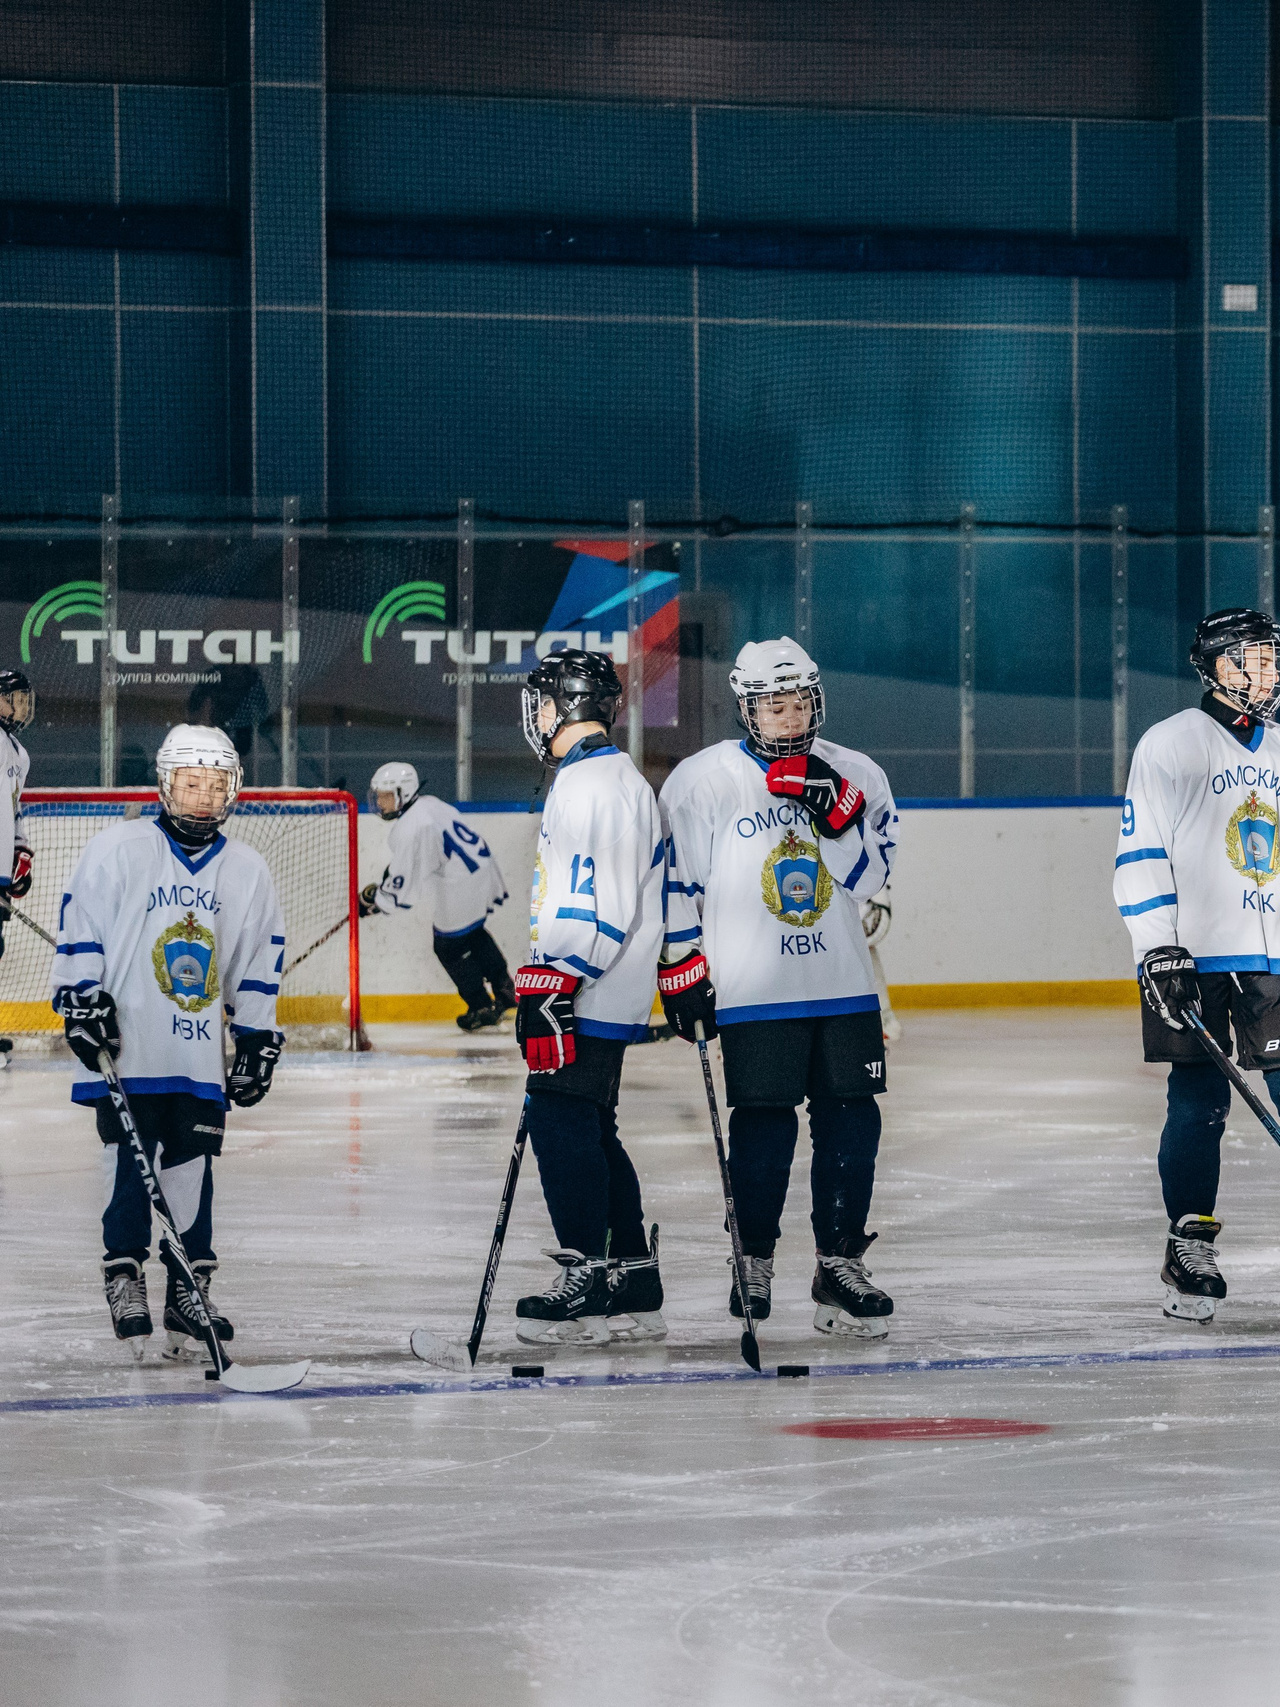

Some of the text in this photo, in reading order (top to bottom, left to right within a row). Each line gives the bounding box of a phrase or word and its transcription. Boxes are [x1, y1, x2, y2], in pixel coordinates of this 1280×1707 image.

[110, 671, 221, 685] руппа компаний
[490, 673, 528, 683] комп
[737, 804, 810, 838] ОМСК
[1121, 799, 1136, 837] 9
[570, 854, 595, 896] 12
[1242, 889, 1276, 914] КК
[780, 931, 827, 955] КВК
[1150, 958, 1195, 974] BAUE
[62, 1006, 110, 1019] CCM
[172, 1014, 212, 1041] КВК
